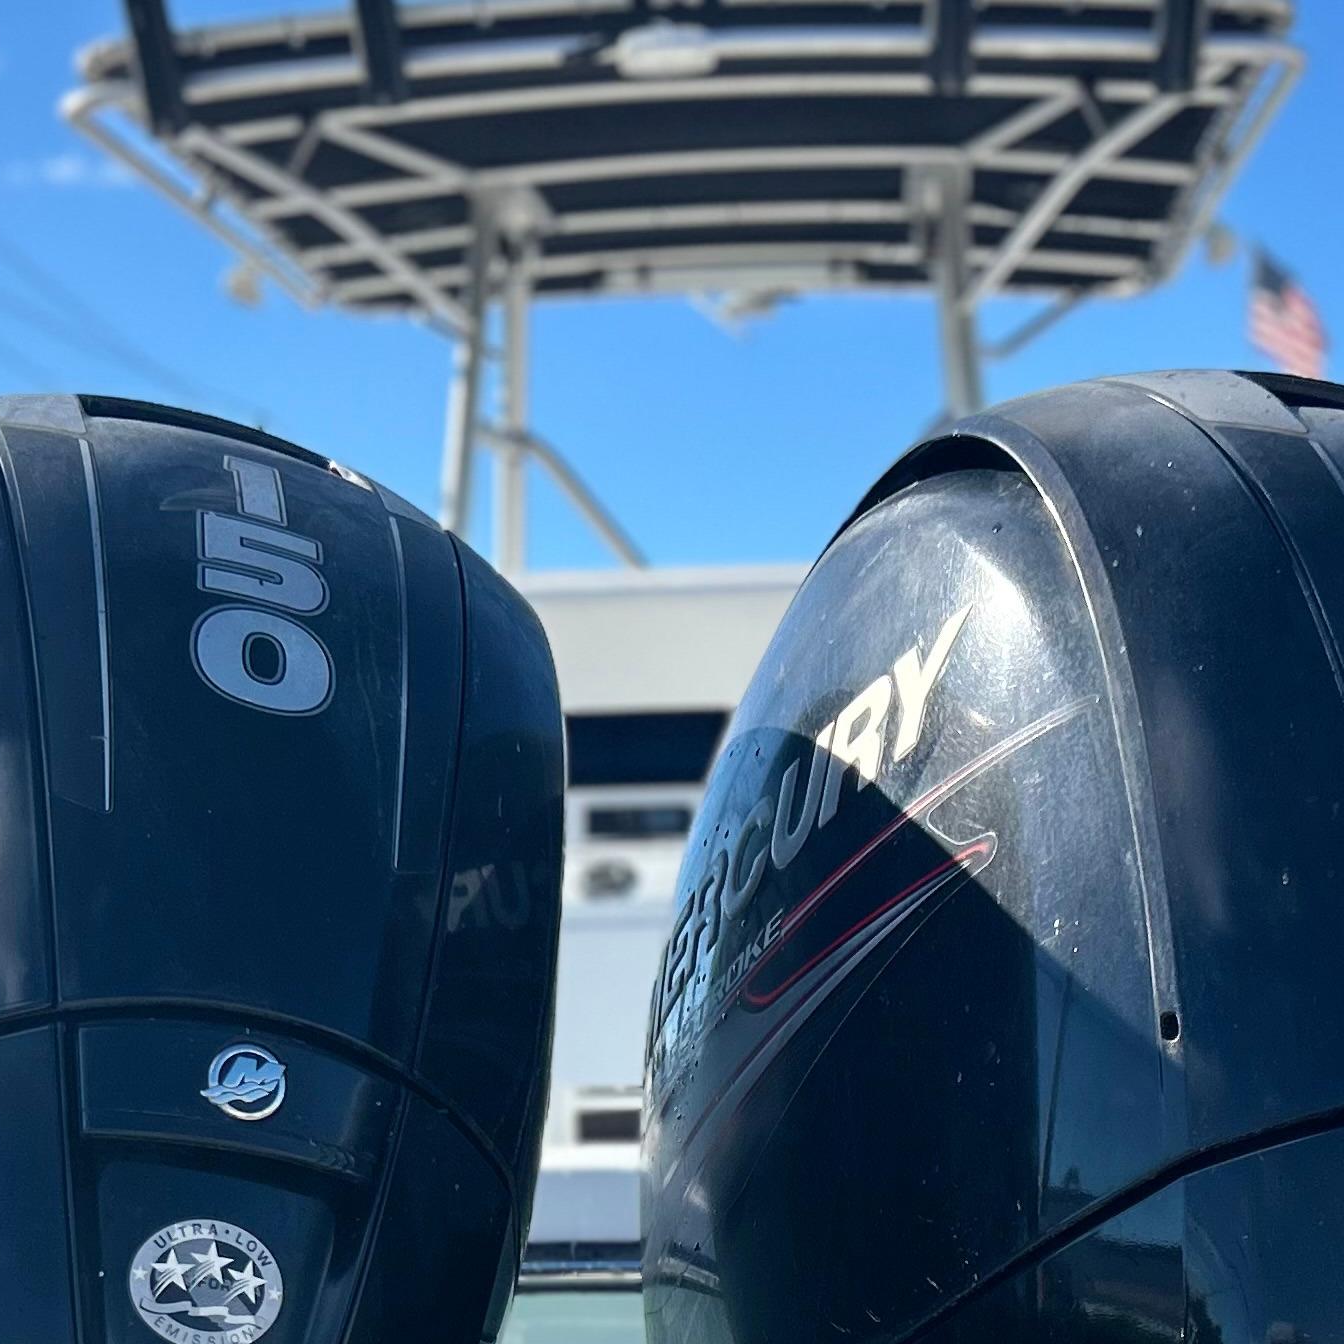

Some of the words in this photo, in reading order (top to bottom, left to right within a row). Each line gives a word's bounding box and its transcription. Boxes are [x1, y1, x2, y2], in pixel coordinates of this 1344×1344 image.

[189, 455, 336, 717] 150
[153, 1223, 218, 1249] ULTRA
[235, 1232, 272, 1267] LOW
